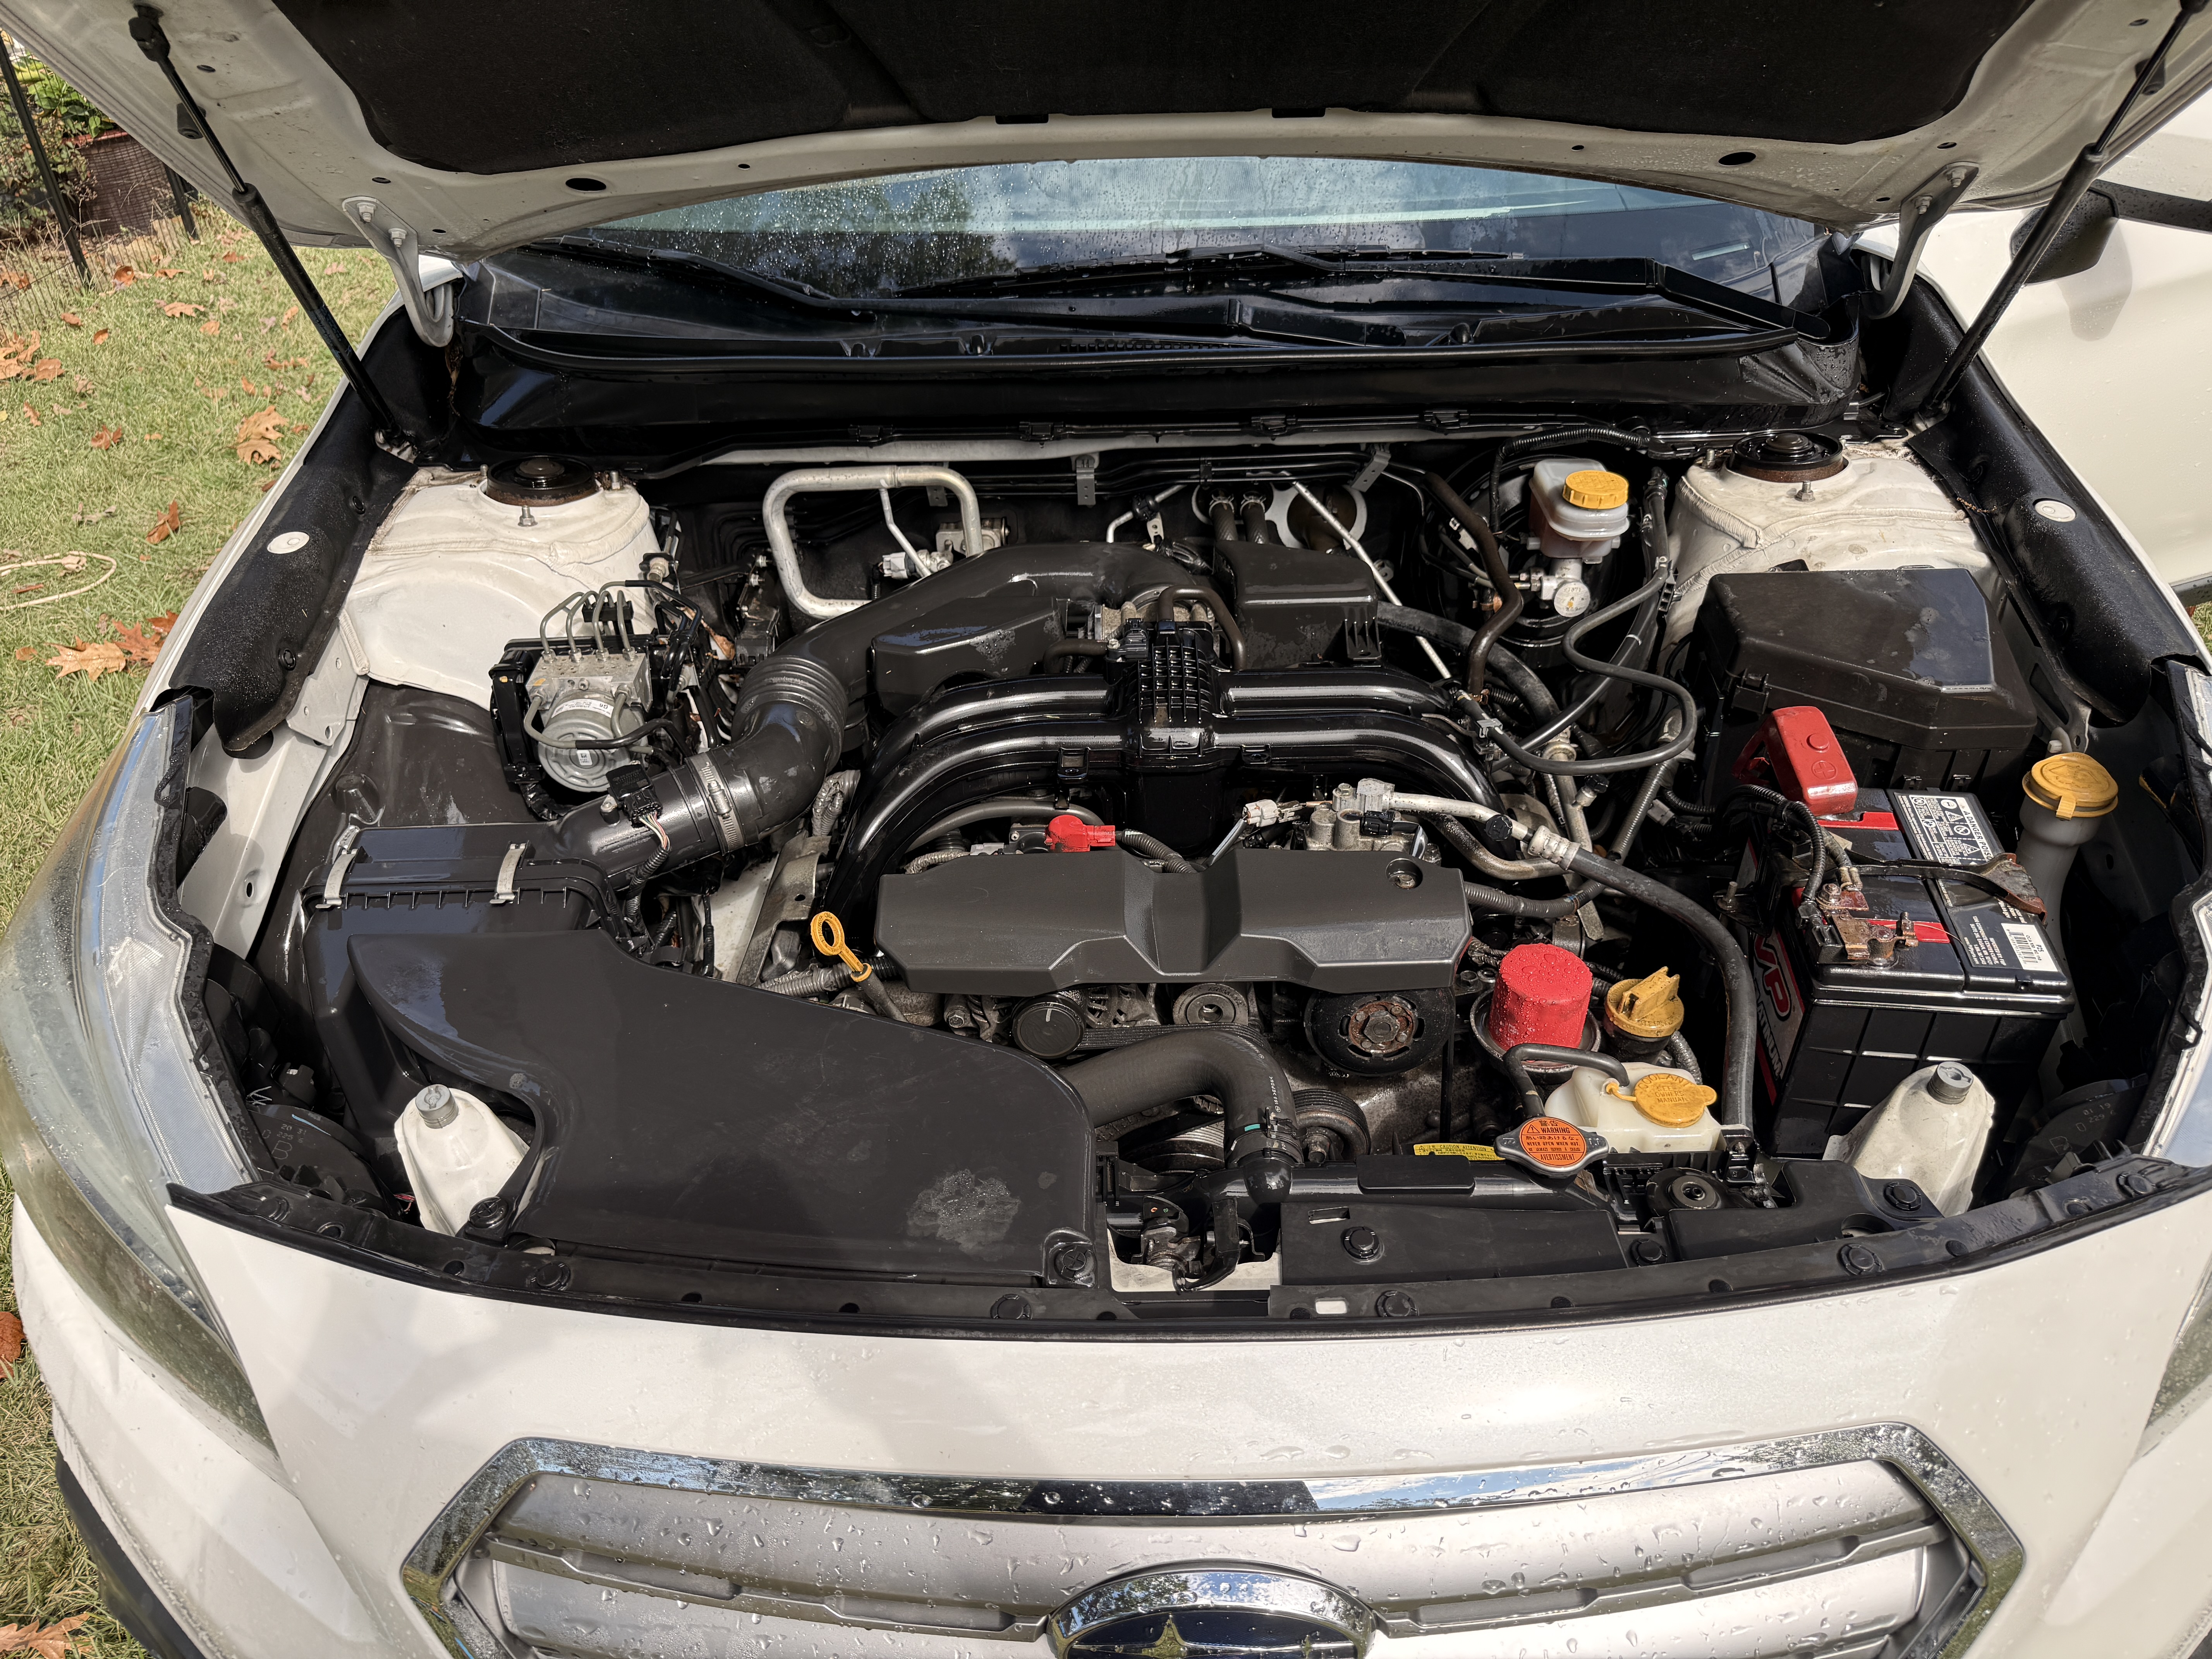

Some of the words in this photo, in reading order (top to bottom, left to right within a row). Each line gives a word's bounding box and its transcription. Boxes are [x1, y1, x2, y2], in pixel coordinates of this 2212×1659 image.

[1966, 816, 1994, 862] DANGER/POISO
[1754, 934, 1791, 1022] VP
[1756, 992, 1782, 1079] ATINUM
[1638, 1074, 1692, 1089] COOLANT
[271, 1140, 293, 1159] B
